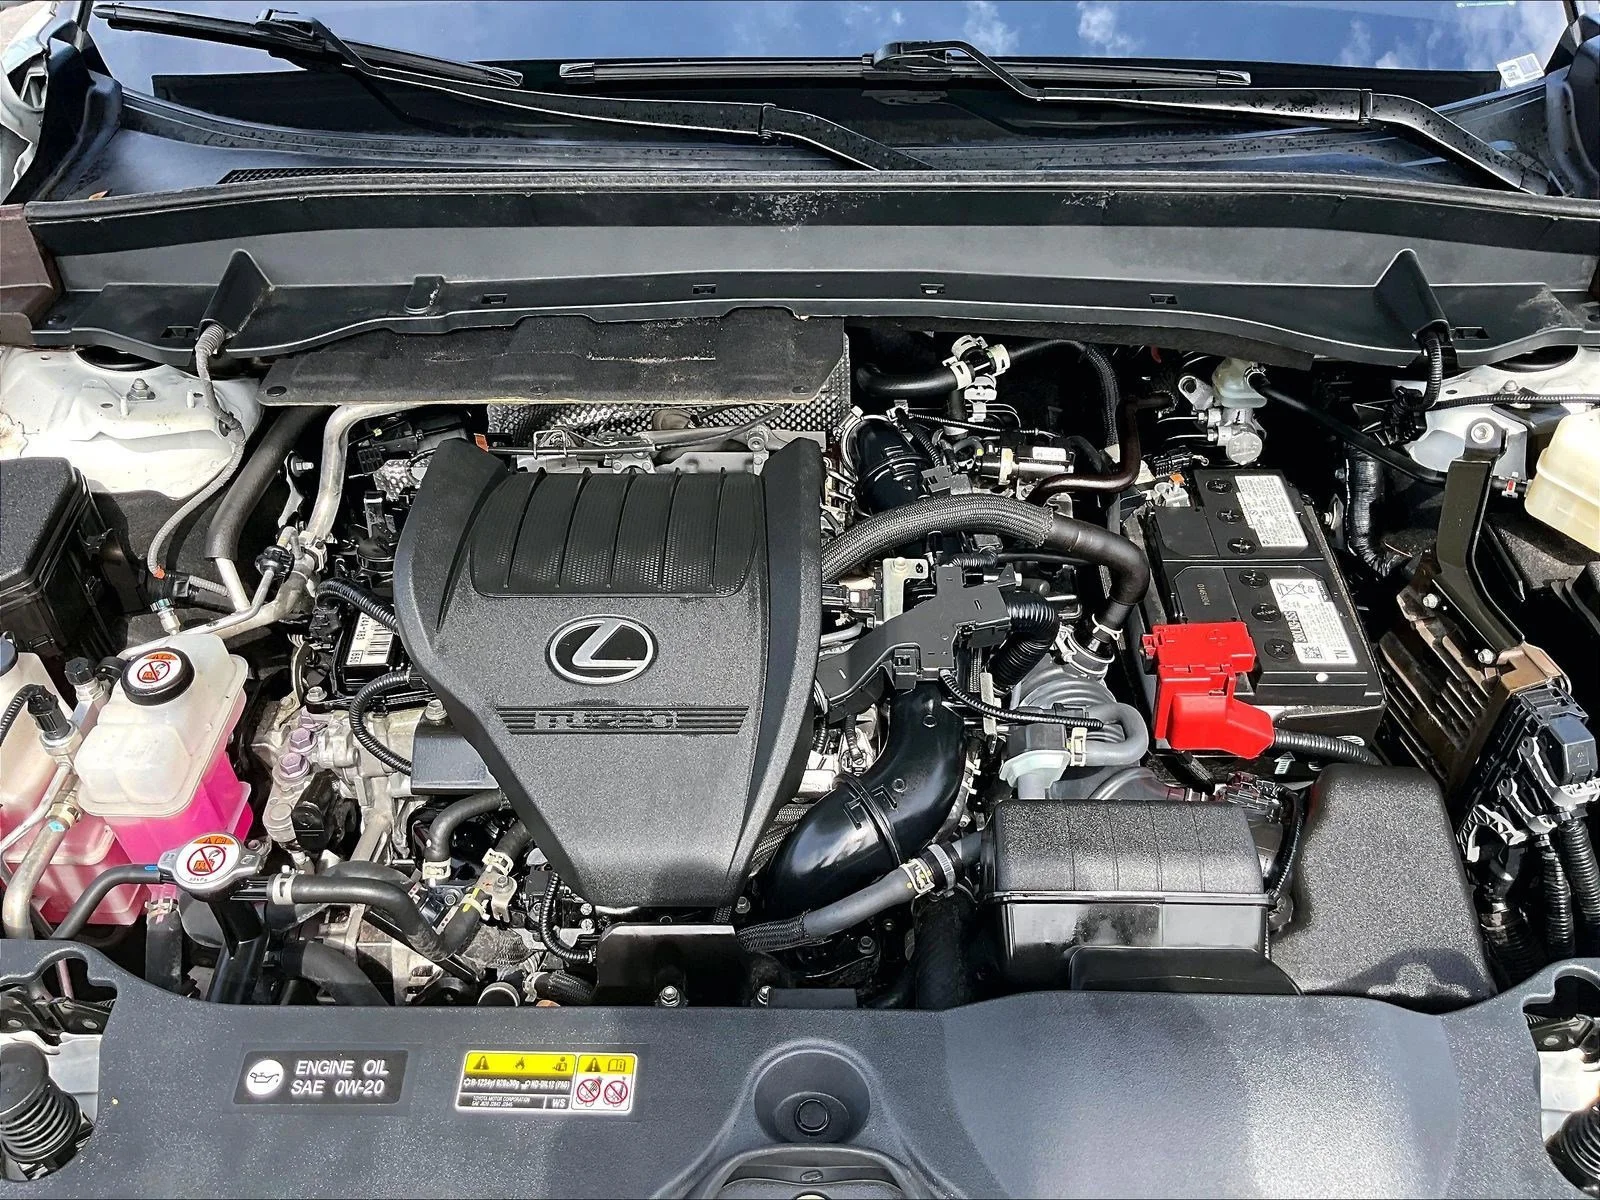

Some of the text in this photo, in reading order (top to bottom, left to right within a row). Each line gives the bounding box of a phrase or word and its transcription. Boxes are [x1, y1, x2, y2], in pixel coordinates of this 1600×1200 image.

[296, 1059, 389, 1075] ENGINE OIL
[291, 1079, 385, 1095] SAE 0W-20
[552, 1098, 566, 1108] WS
